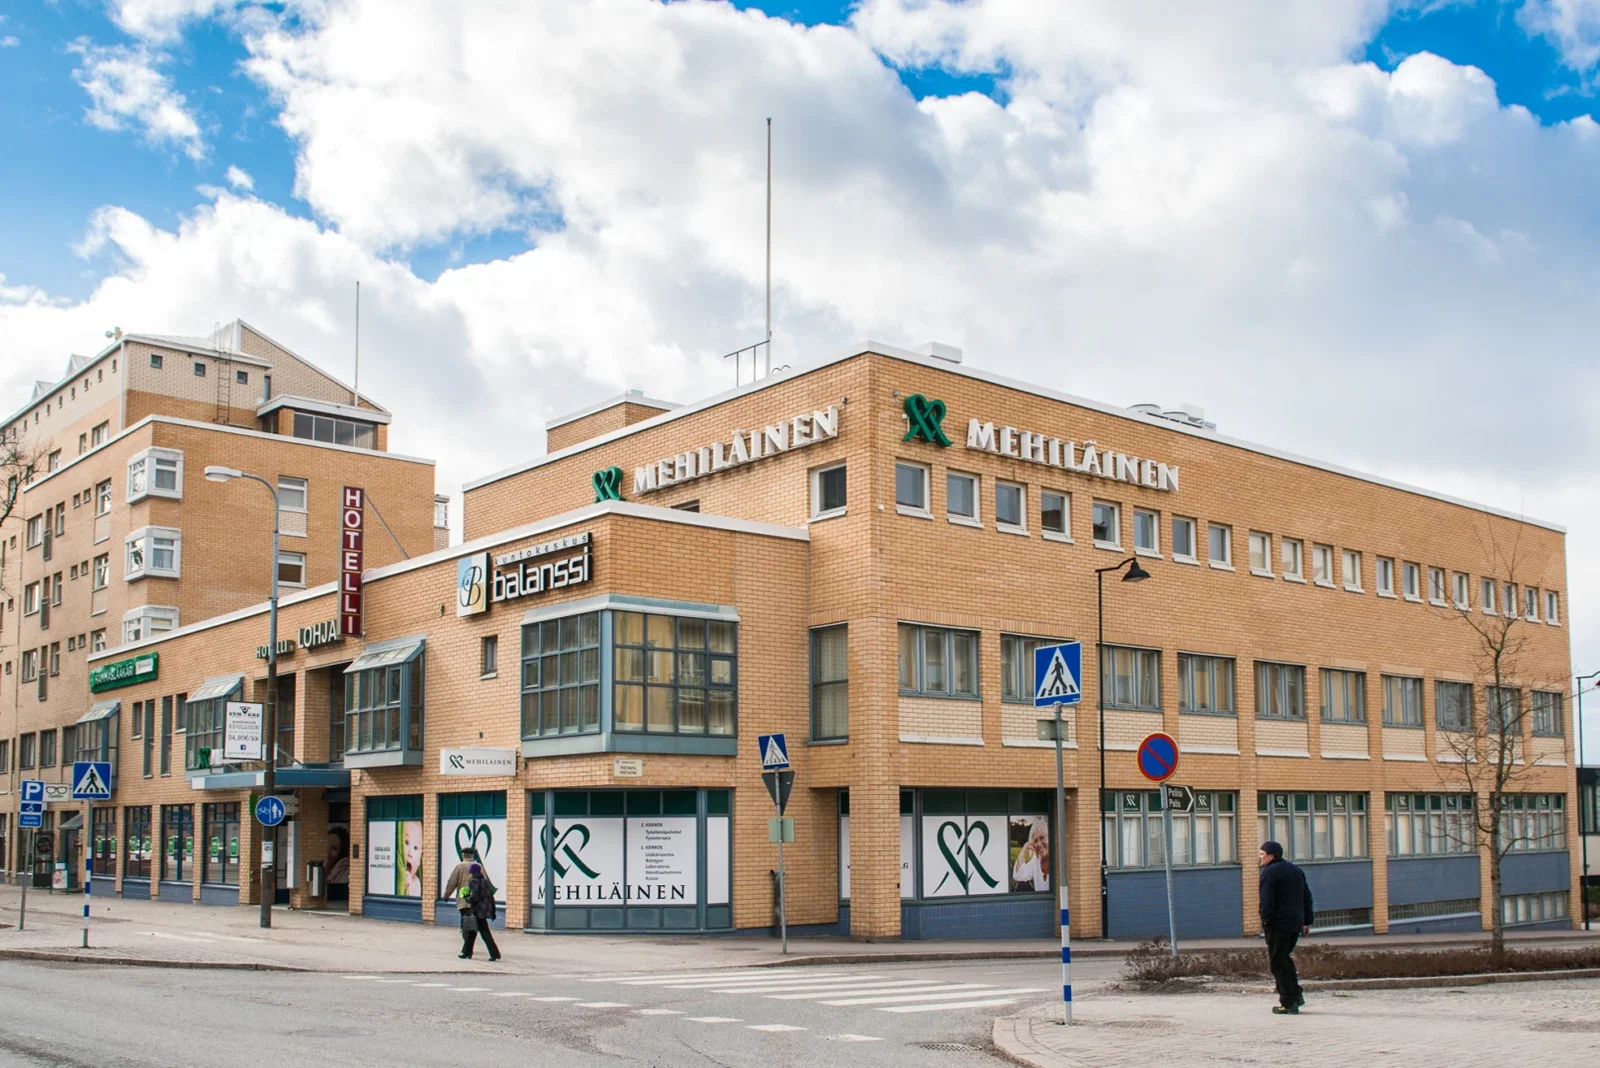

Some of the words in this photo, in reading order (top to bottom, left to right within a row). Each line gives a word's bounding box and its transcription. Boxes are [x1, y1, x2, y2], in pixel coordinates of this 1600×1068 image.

[634, 405, 839, 496] MEHILÄINEN
[966, 418, 1180, 492] MEHILÄINEN
[343, 488, 361, 634] HOTELLI
[494, 534, 588, 566] kuntokeskus
[492, 545, 590, 602] balanssi
[256, 639, 288, 658] HOTLLI
[297, 619, 337, 649] LOHJA
[25, 782, 41, 800] P
[1169, 799, 1181, 808] Polis
[537, 881, 686, 900] MEHILÄINEN
